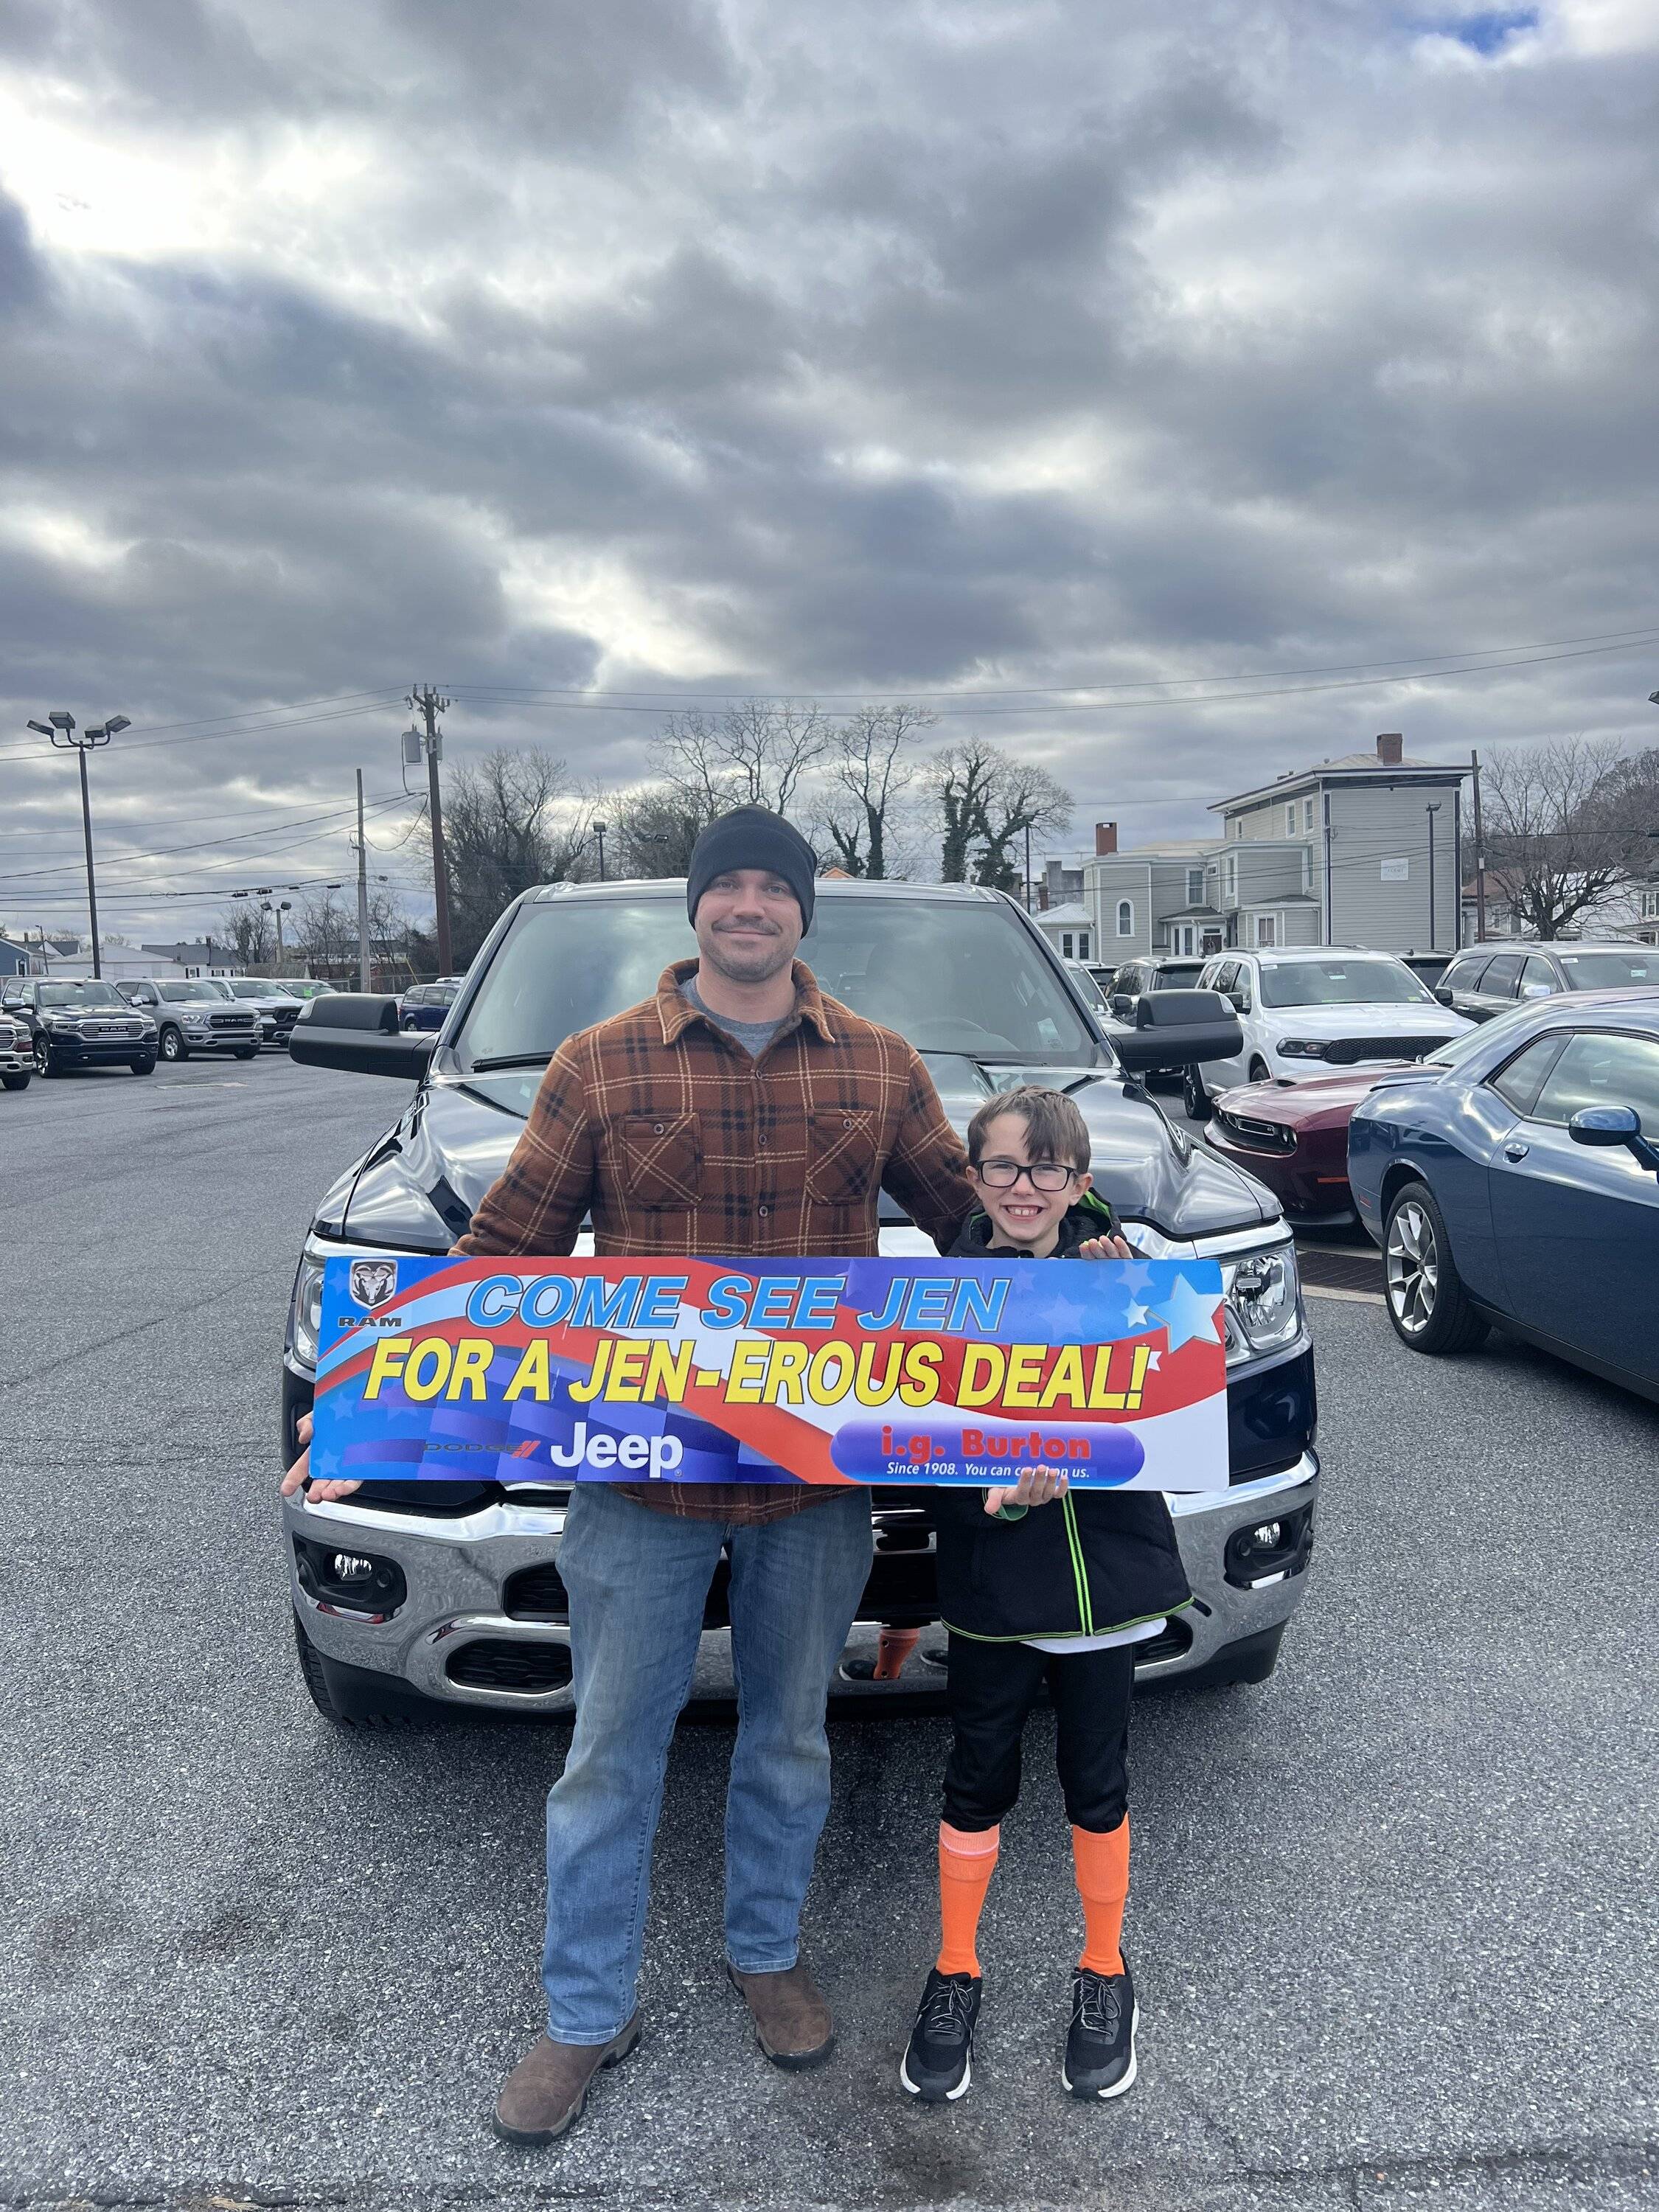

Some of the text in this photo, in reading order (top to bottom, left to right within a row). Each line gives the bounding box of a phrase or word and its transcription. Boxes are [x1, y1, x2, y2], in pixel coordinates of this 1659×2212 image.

[338, 1315, 402, 1327] RAM
[466, 1273, 1012, 1332] COME SEE JEN
[363, 1337, 1152, 1410] FOR A JEN-EROUS DEAL!
[423, 1443, 522, 1452] DODGE
[550, 1422, 684, 1478] Jeep
[881, 1425, 1091, 1464] i.g. Burton
[887, 1461, 919, 1475] Since
[924, 1462, 959, 1475] 1908.
[964, 1463, 987, 1476] You
[990, 1466, 1011, 1477] can
[1072, 1468, 1091, 1478] us.
